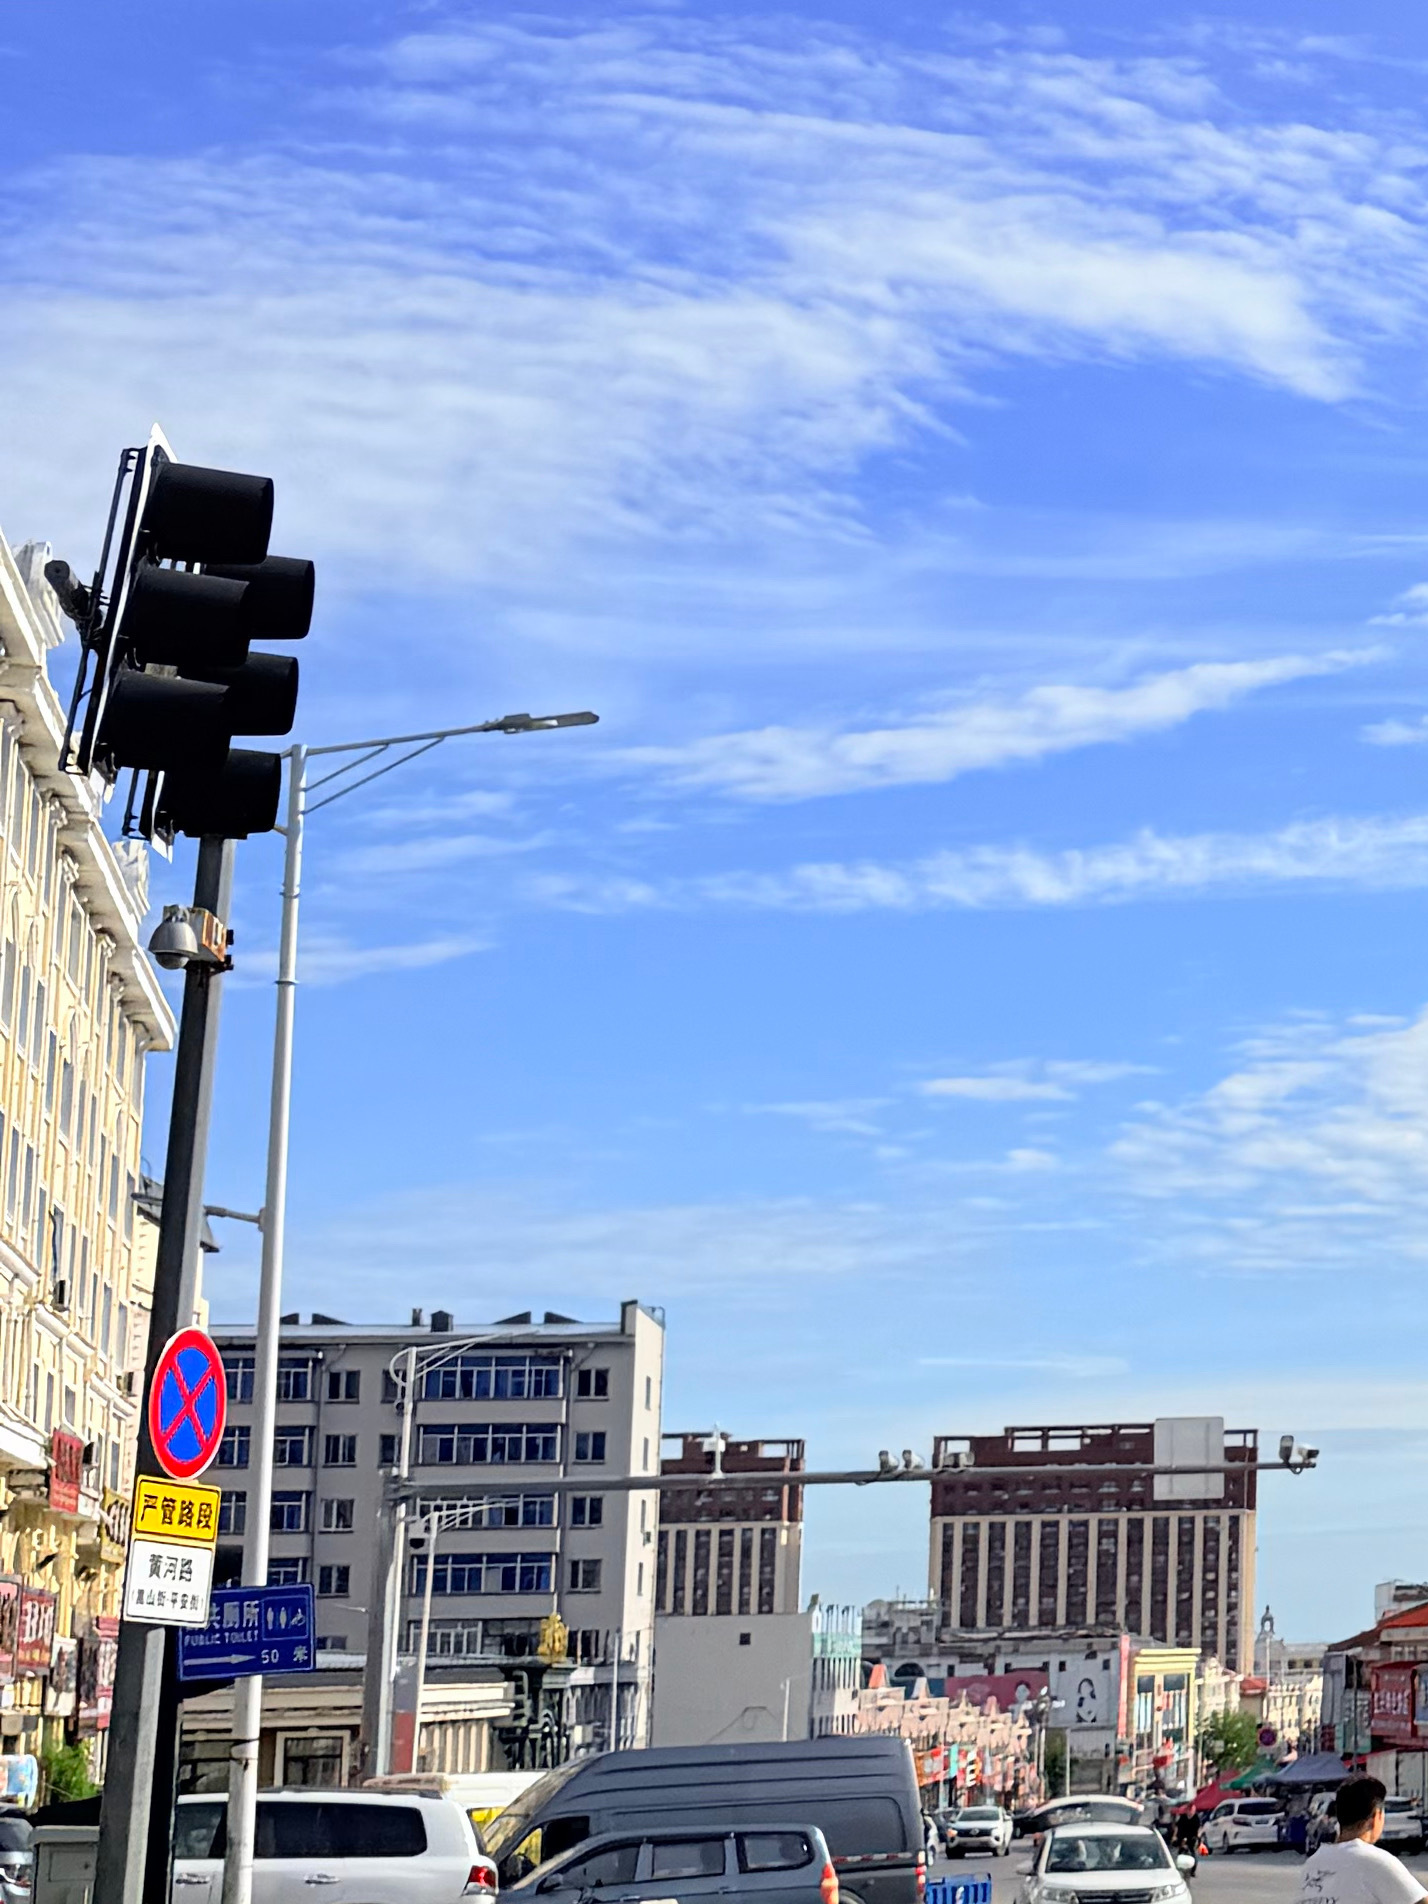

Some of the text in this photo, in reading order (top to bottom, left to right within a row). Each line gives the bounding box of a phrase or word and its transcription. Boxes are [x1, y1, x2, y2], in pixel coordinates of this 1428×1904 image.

[140, 1493, 213, 1530] 严管路段
[148, 1553, 193, 1582] 黄河路
[260, 1649, 280, 1664] 50
